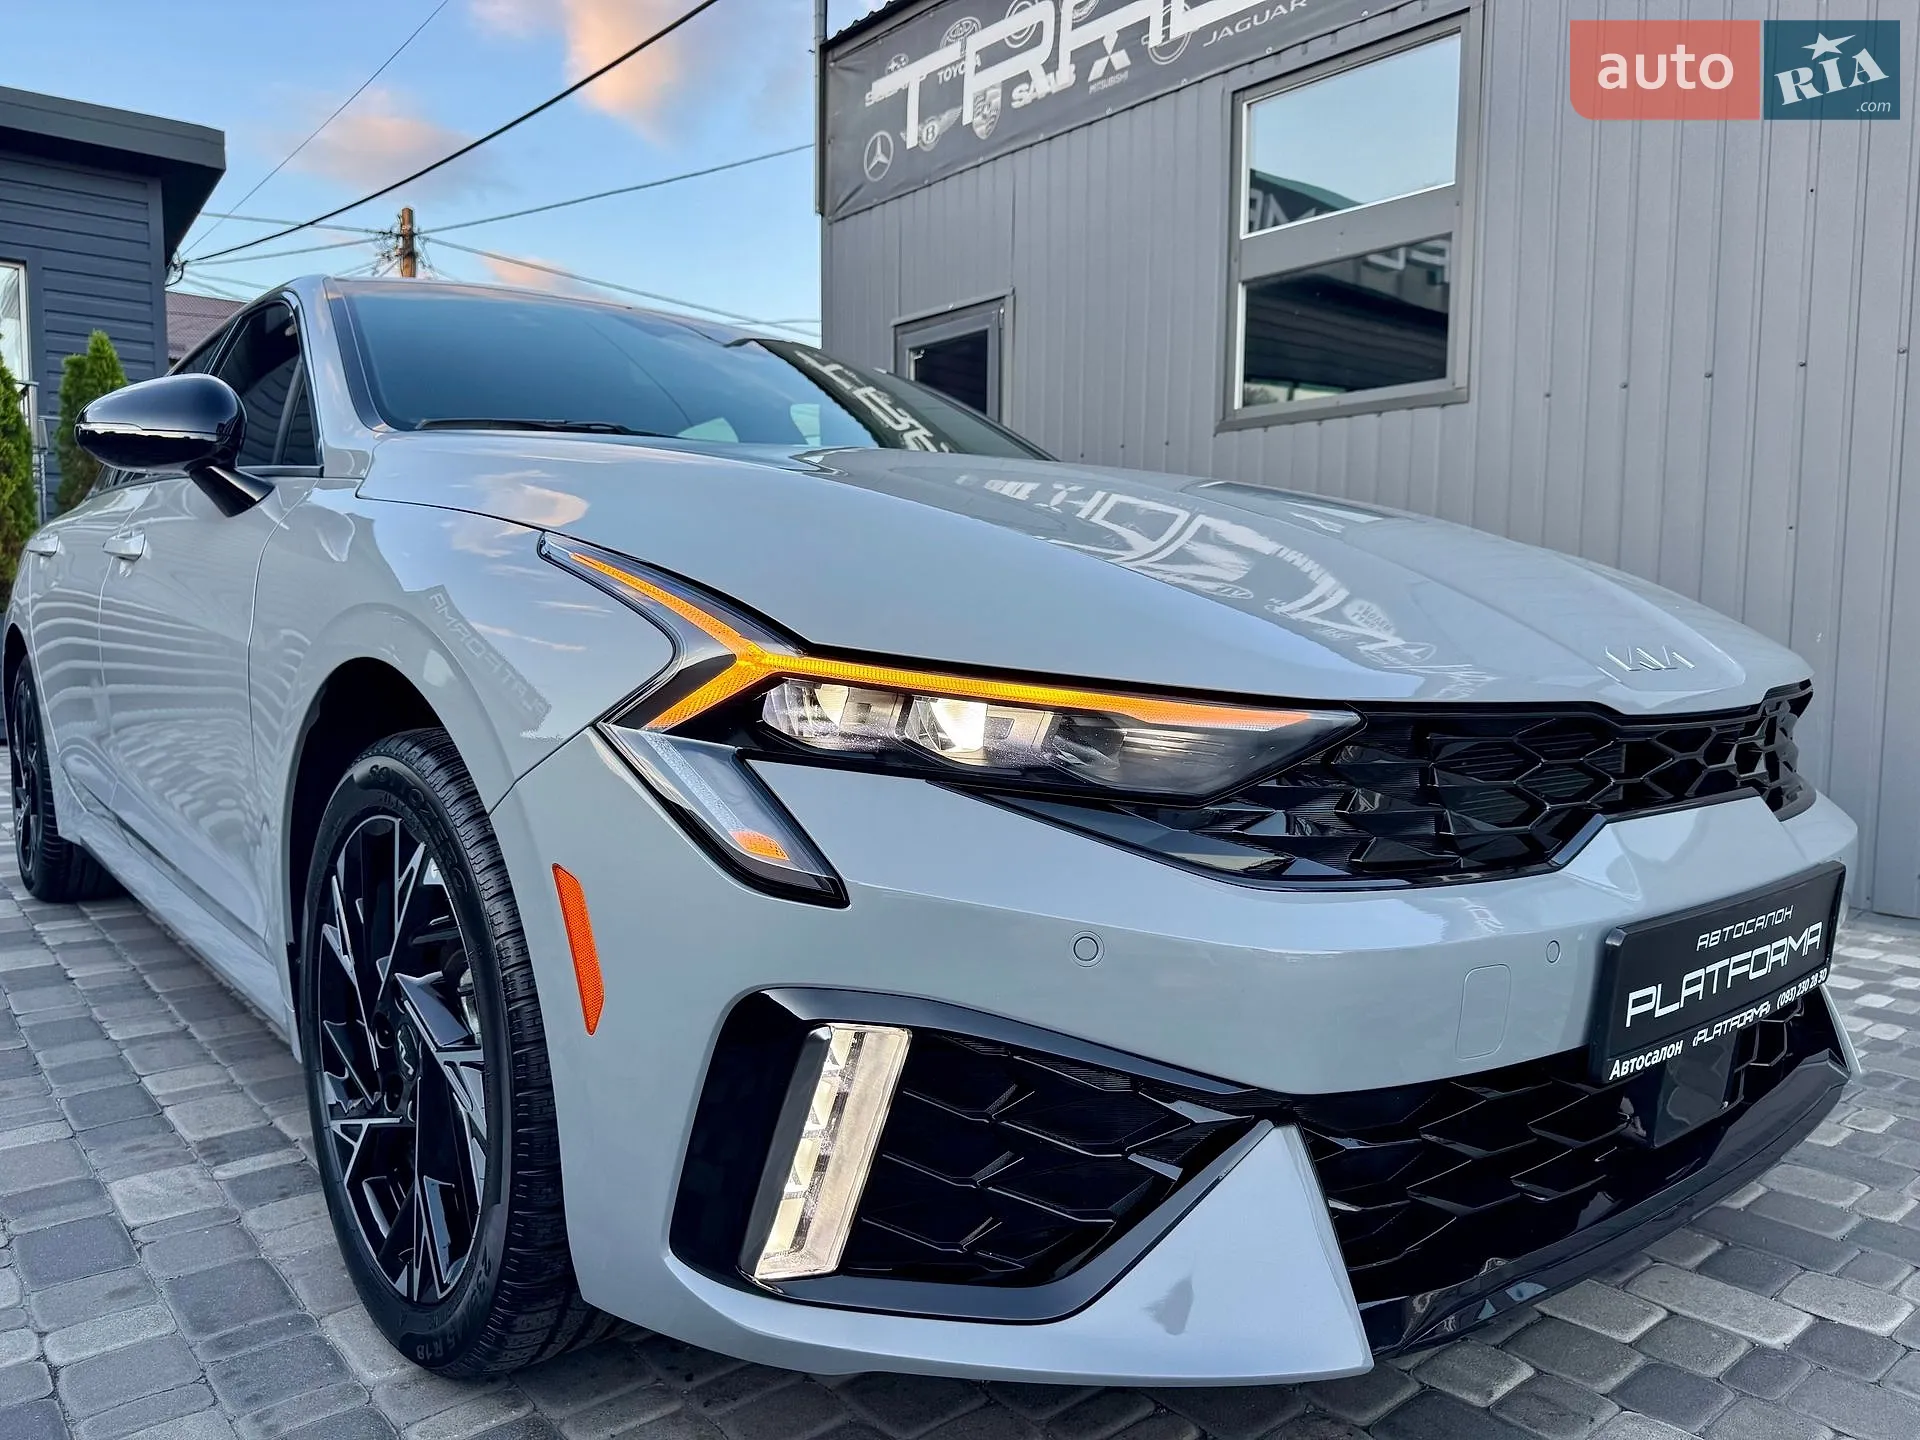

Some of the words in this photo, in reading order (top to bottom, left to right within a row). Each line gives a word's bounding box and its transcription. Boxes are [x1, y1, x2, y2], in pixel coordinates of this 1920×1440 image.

[1202, 0, 1308, 47] JAGUAR
[1696, 904, 1794, 951] АВТОСАЛОН
[1625, 921, 1823, 1028] PLATFORMA
[1609, 1040, 1684, 1081] Автосалон
